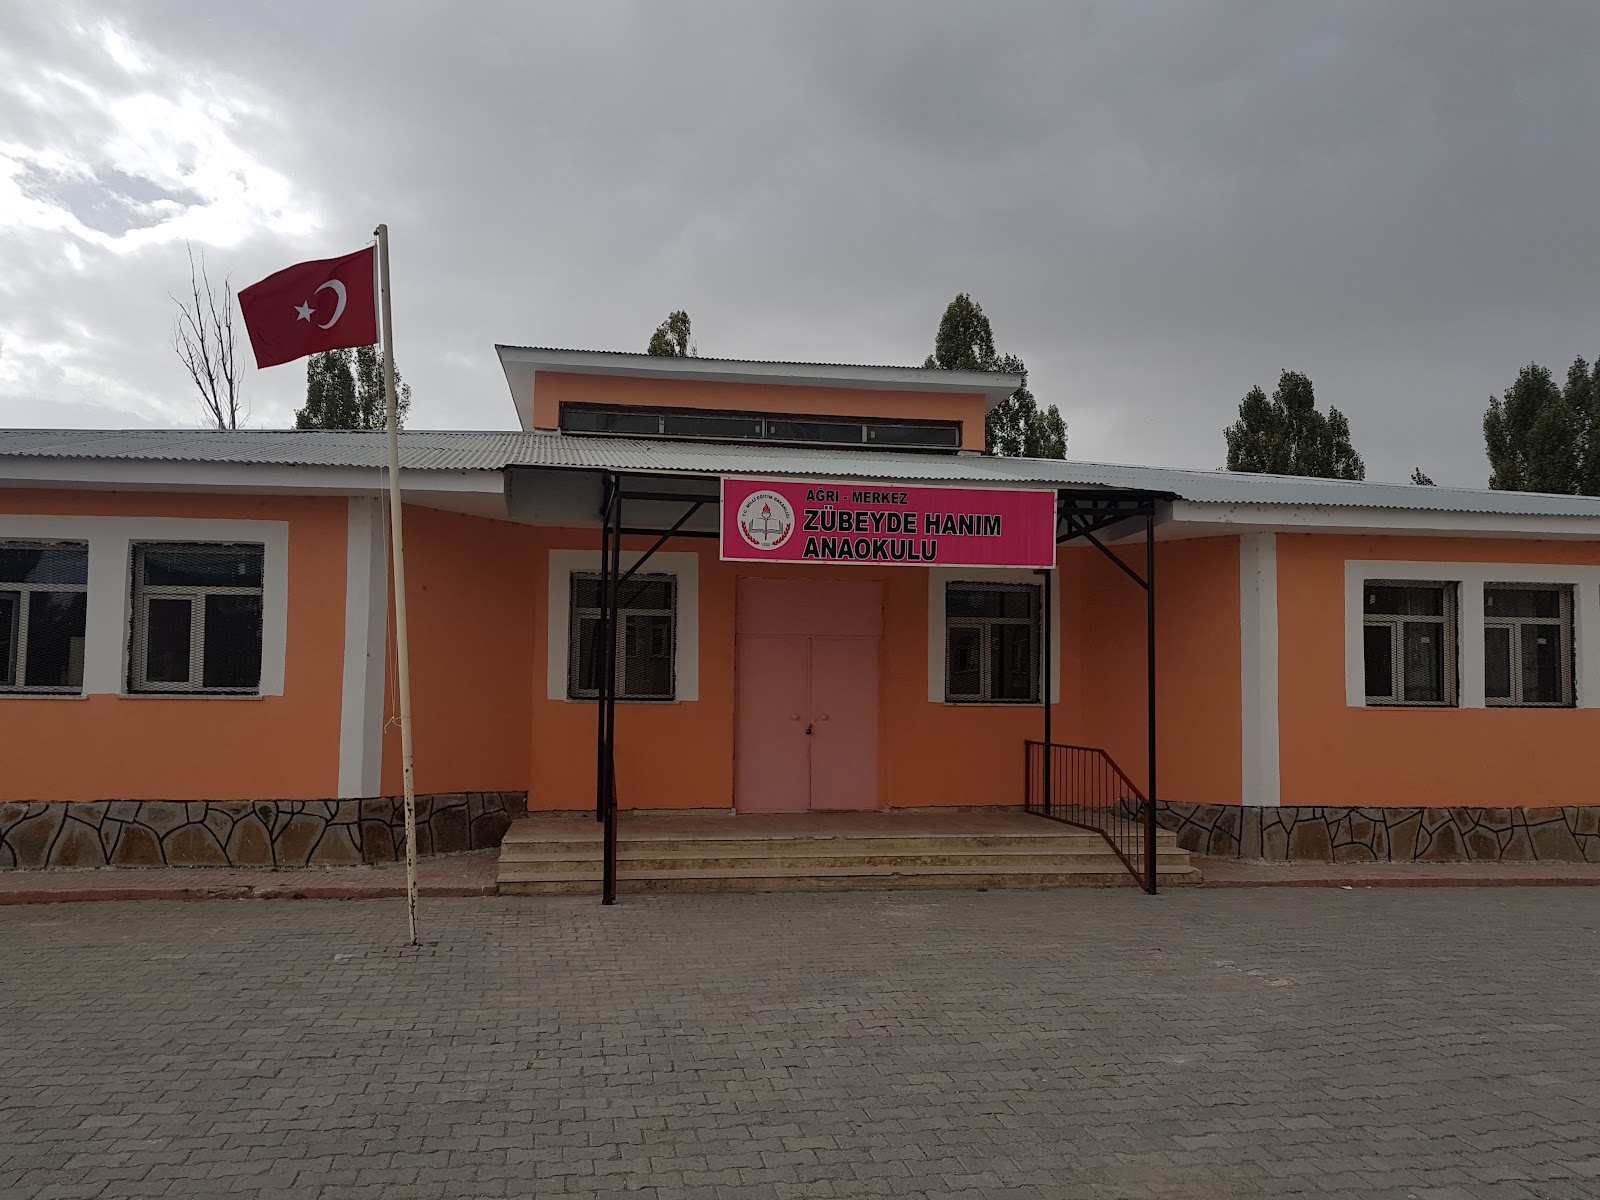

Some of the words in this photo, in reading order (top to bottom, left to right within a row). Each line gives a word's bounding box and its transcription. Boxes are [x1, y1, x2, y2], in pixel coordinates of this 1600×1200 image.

[806, 487, 839, 502] AĞRI
[852, 491, 908, 504] MERKEZ
[803, 505, 917, 533] ZÜBEYDE
[924, 513, 1001, 536] HANIM
[803, 537, 937, 561] ANAOKULU
